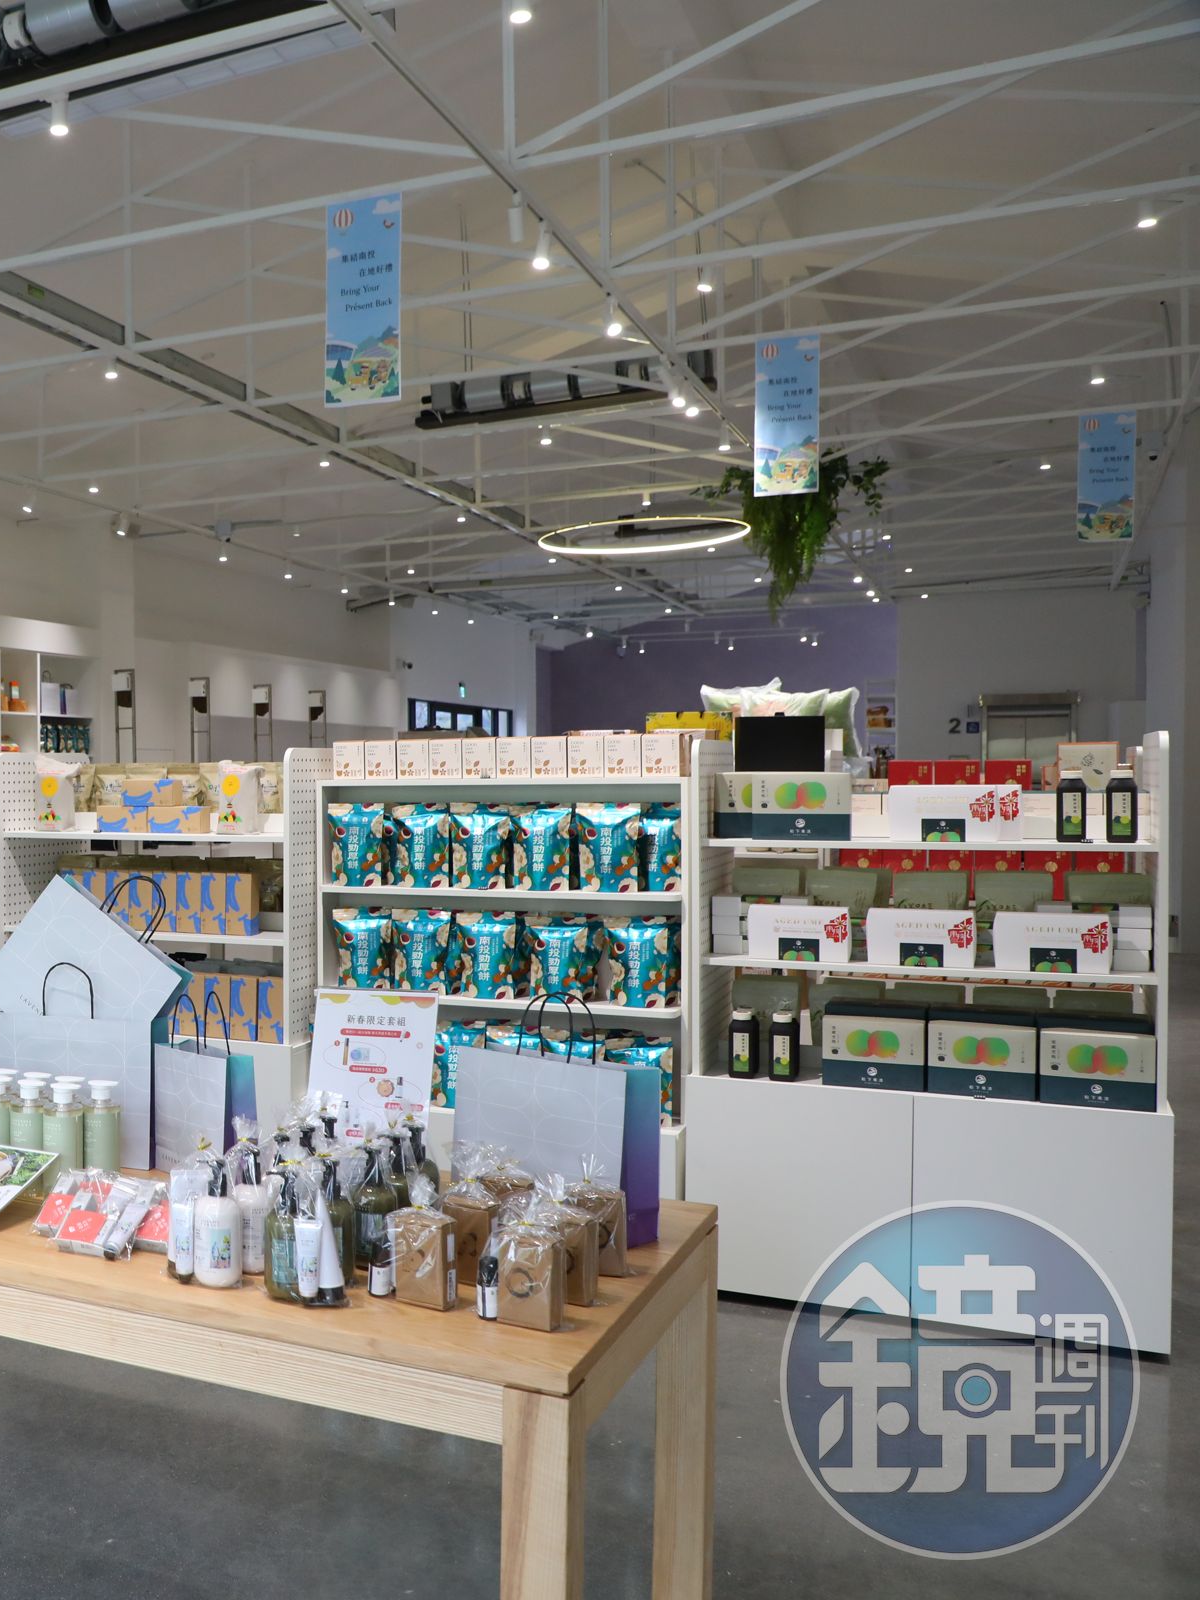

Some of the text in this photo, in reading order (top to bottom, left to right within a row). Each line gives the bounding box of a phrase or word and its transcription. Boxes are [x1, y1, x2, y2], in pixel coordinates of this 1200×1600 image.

[340, 284, 380, 297] Bring Your
[375, 297, 393, 308] Back
[949, 718, 961, 734] 2
[347, 1014, 406, 1027] 新春限定套組
